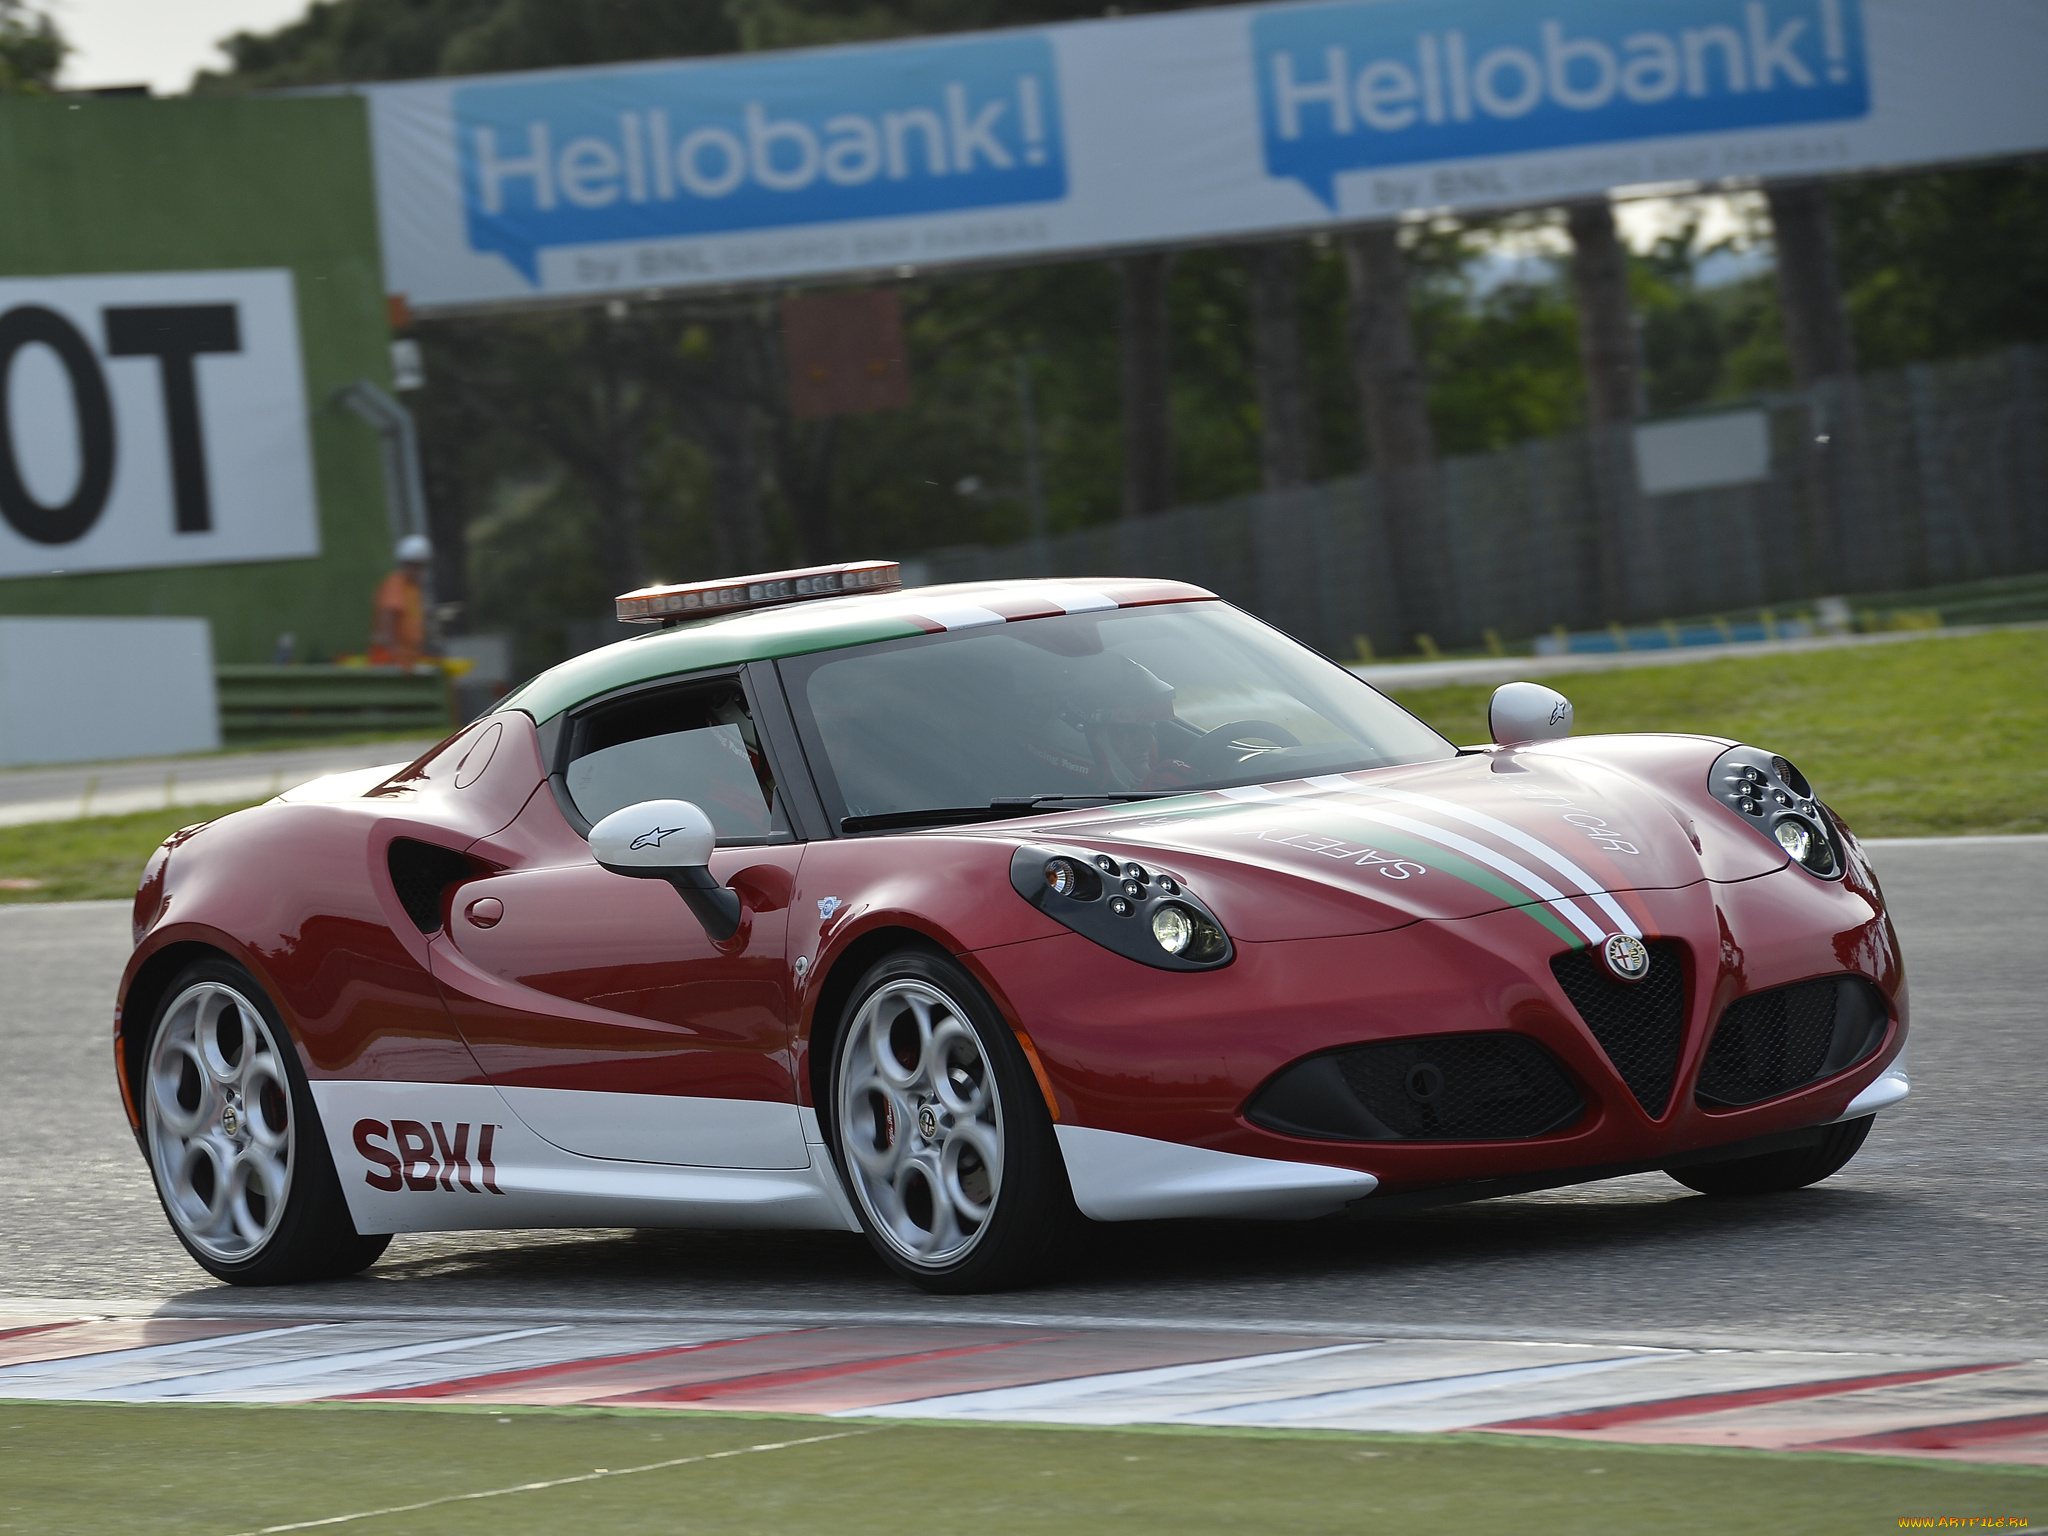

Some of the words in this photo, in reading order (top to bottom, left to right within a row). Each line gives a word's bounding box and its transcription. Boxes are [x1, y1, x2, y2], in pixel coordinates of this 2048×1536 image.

[1272, 0, 1848, 139] Hellobank!
[474, 75, 1048, 213] Hellobank!
[1235, 828, 1427, 881] SAFETY
[1562, 813, 1641, 855] CAR
